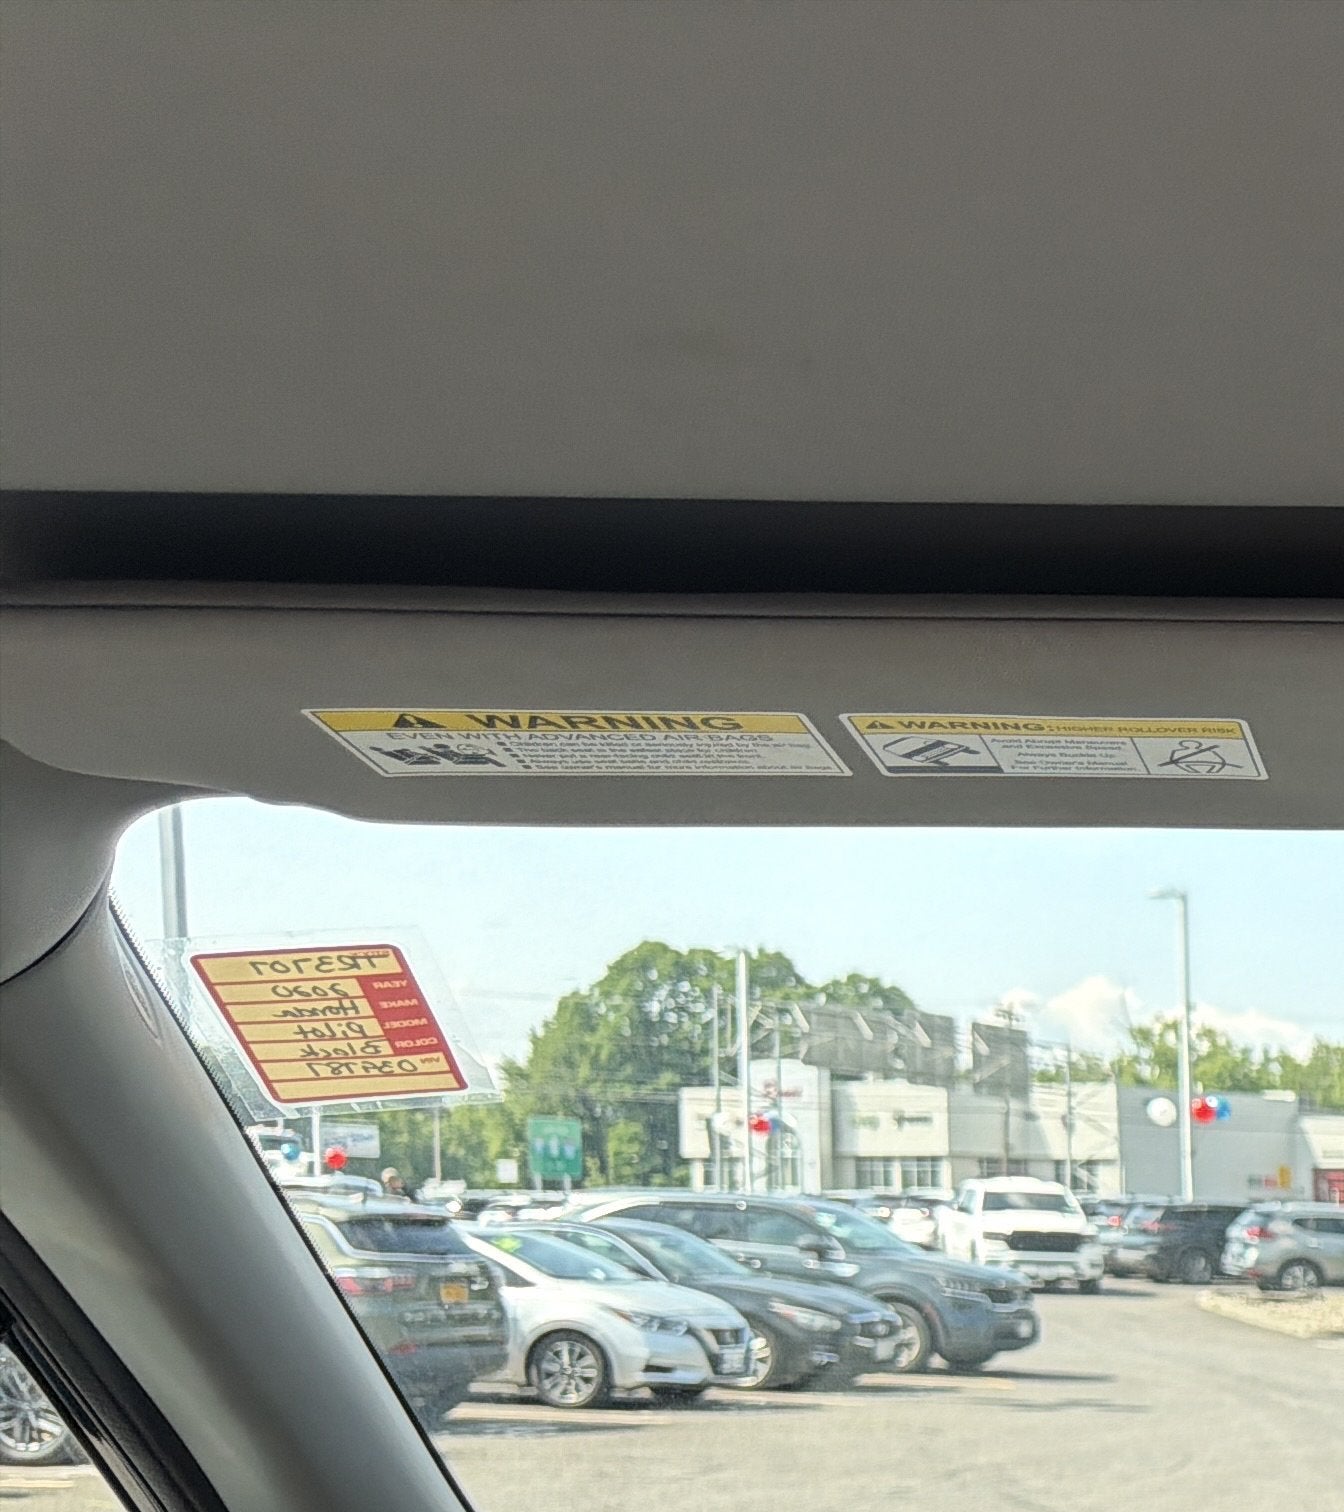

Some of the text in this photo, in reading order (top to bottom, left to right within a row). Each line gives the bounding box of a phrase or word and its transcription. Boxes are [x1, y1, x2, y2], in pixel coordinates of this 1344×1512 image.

[465, 714, 744, 731] WARNING
[1056, 725, 1114, 733] HIGHER
[1118, 725, 1197, 734] ROLLOVER
[1201, 727, 1236, 735] RISK
[386, 732, 774, 742] EVEN WITH ADVANCED AIR BAGS
